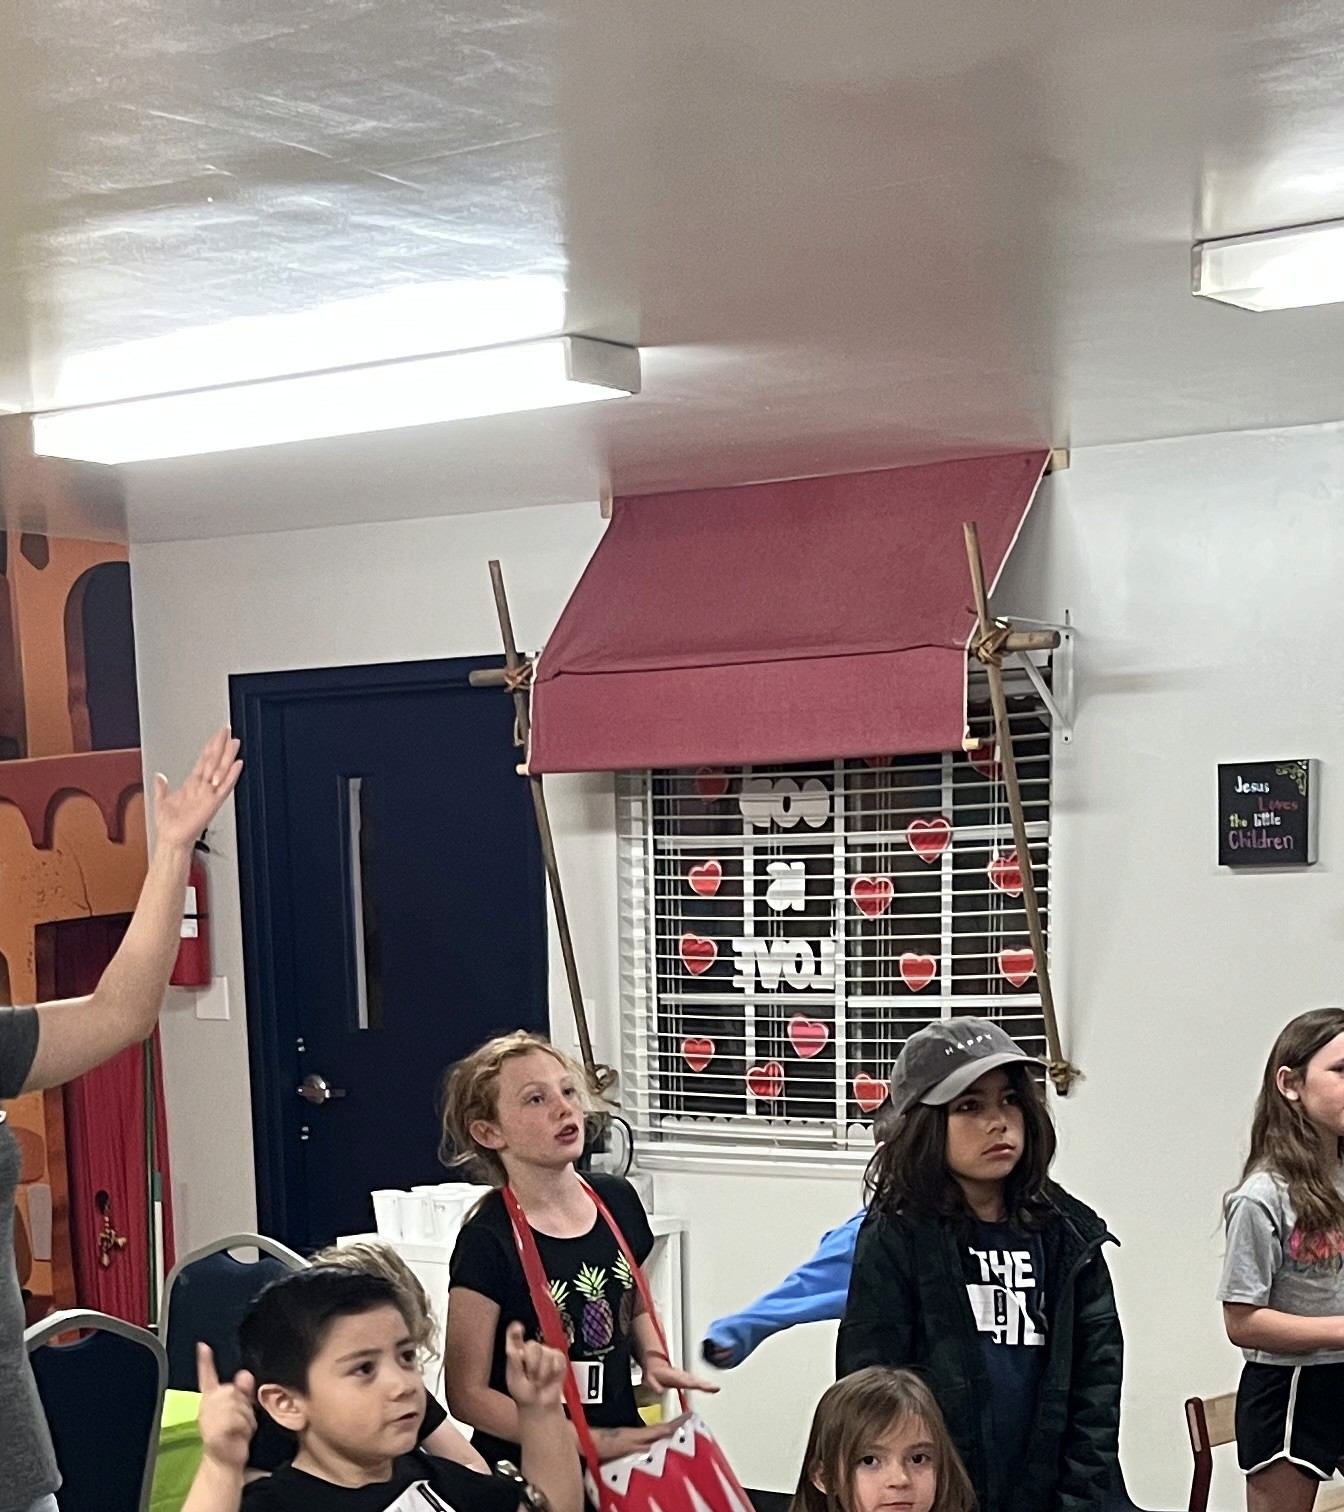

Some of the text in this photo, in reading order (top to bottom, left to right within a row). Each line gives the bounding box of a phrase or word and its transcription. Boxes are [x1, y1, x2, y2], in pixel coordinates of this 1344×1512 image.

[1234, 775, 1270, 793] Jesus
[1258, 796, 1298, 812] Loves
[1228, 811, 1282, 827] the little
[1228, 828, 1294, 850] Children
[944, 1033, 993, 1056] HAPPY
[967, 1245, 1036, 1288] THE
